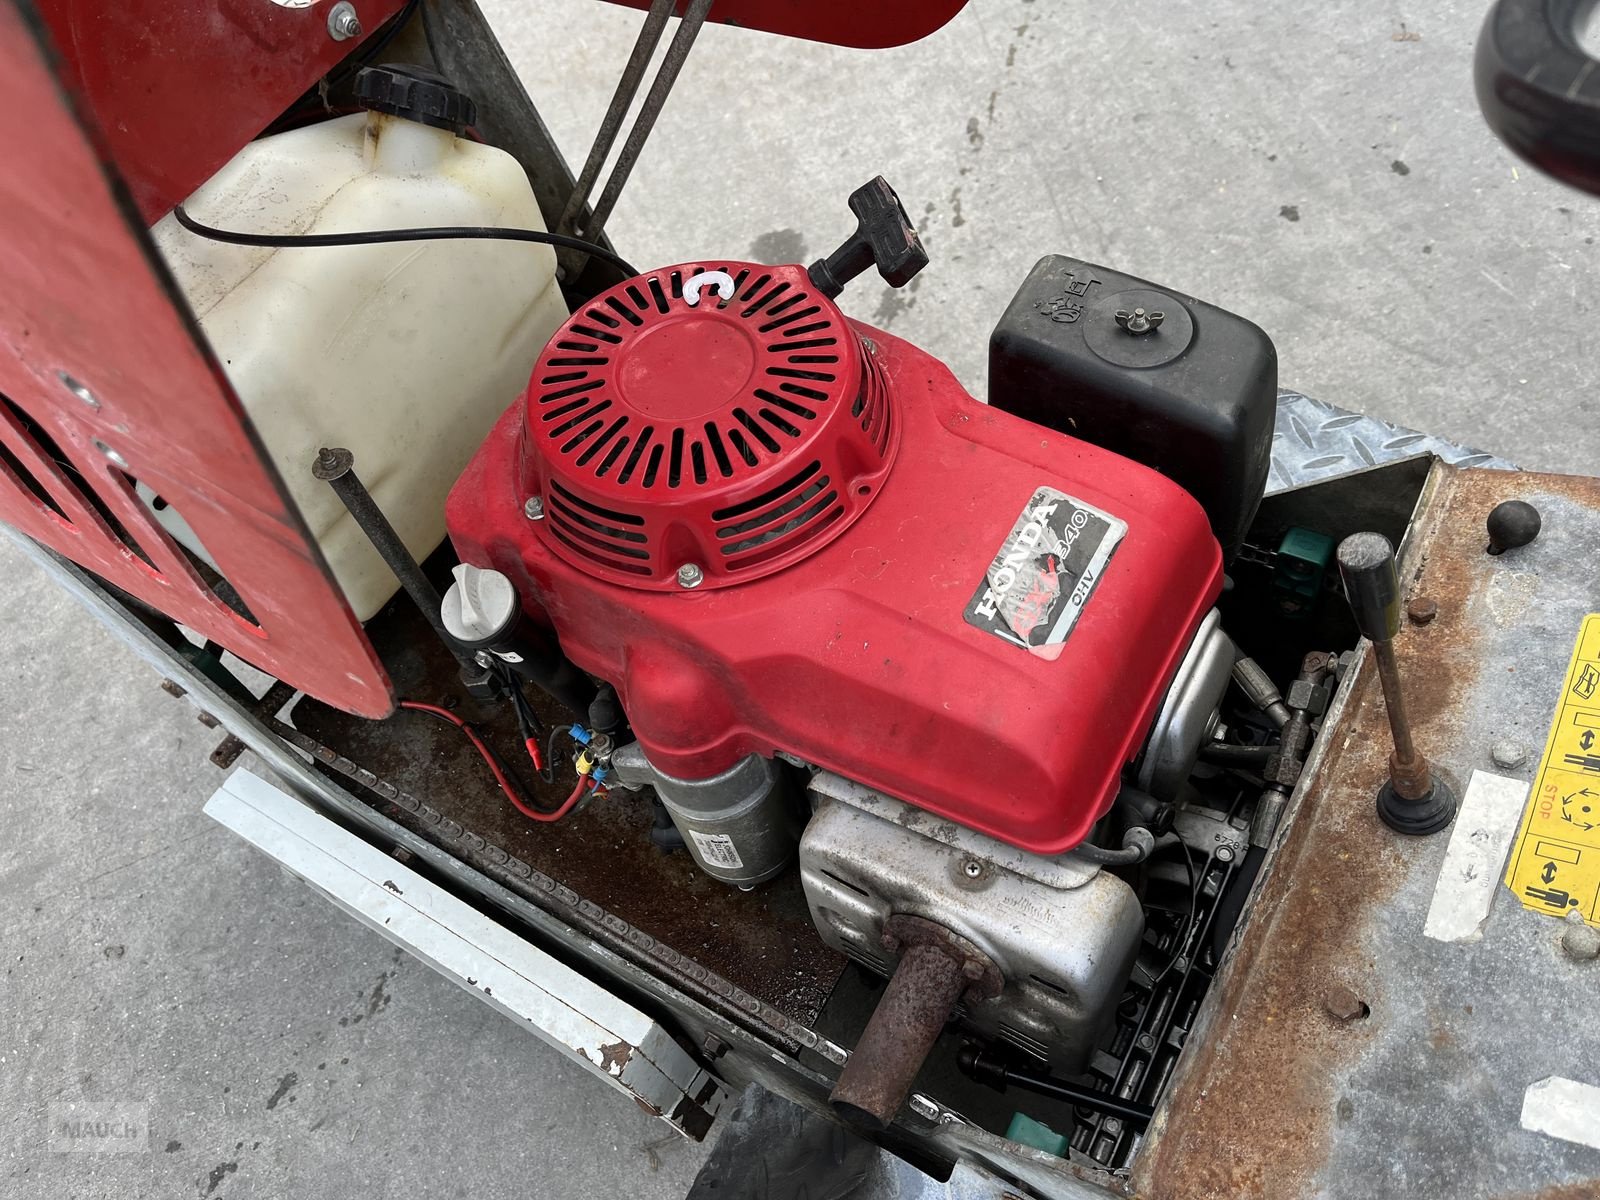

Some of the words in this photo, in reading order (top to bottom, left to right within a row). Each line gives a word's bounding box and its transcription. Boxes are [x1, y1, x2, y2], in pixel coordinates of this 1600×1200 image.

[1053, 509, 1089, 560] 340
[974, 503, 1059, 621] HONDA
[1071, 569, 1094, 607] OHV
[1540, 784, 1558, 819] STOP
